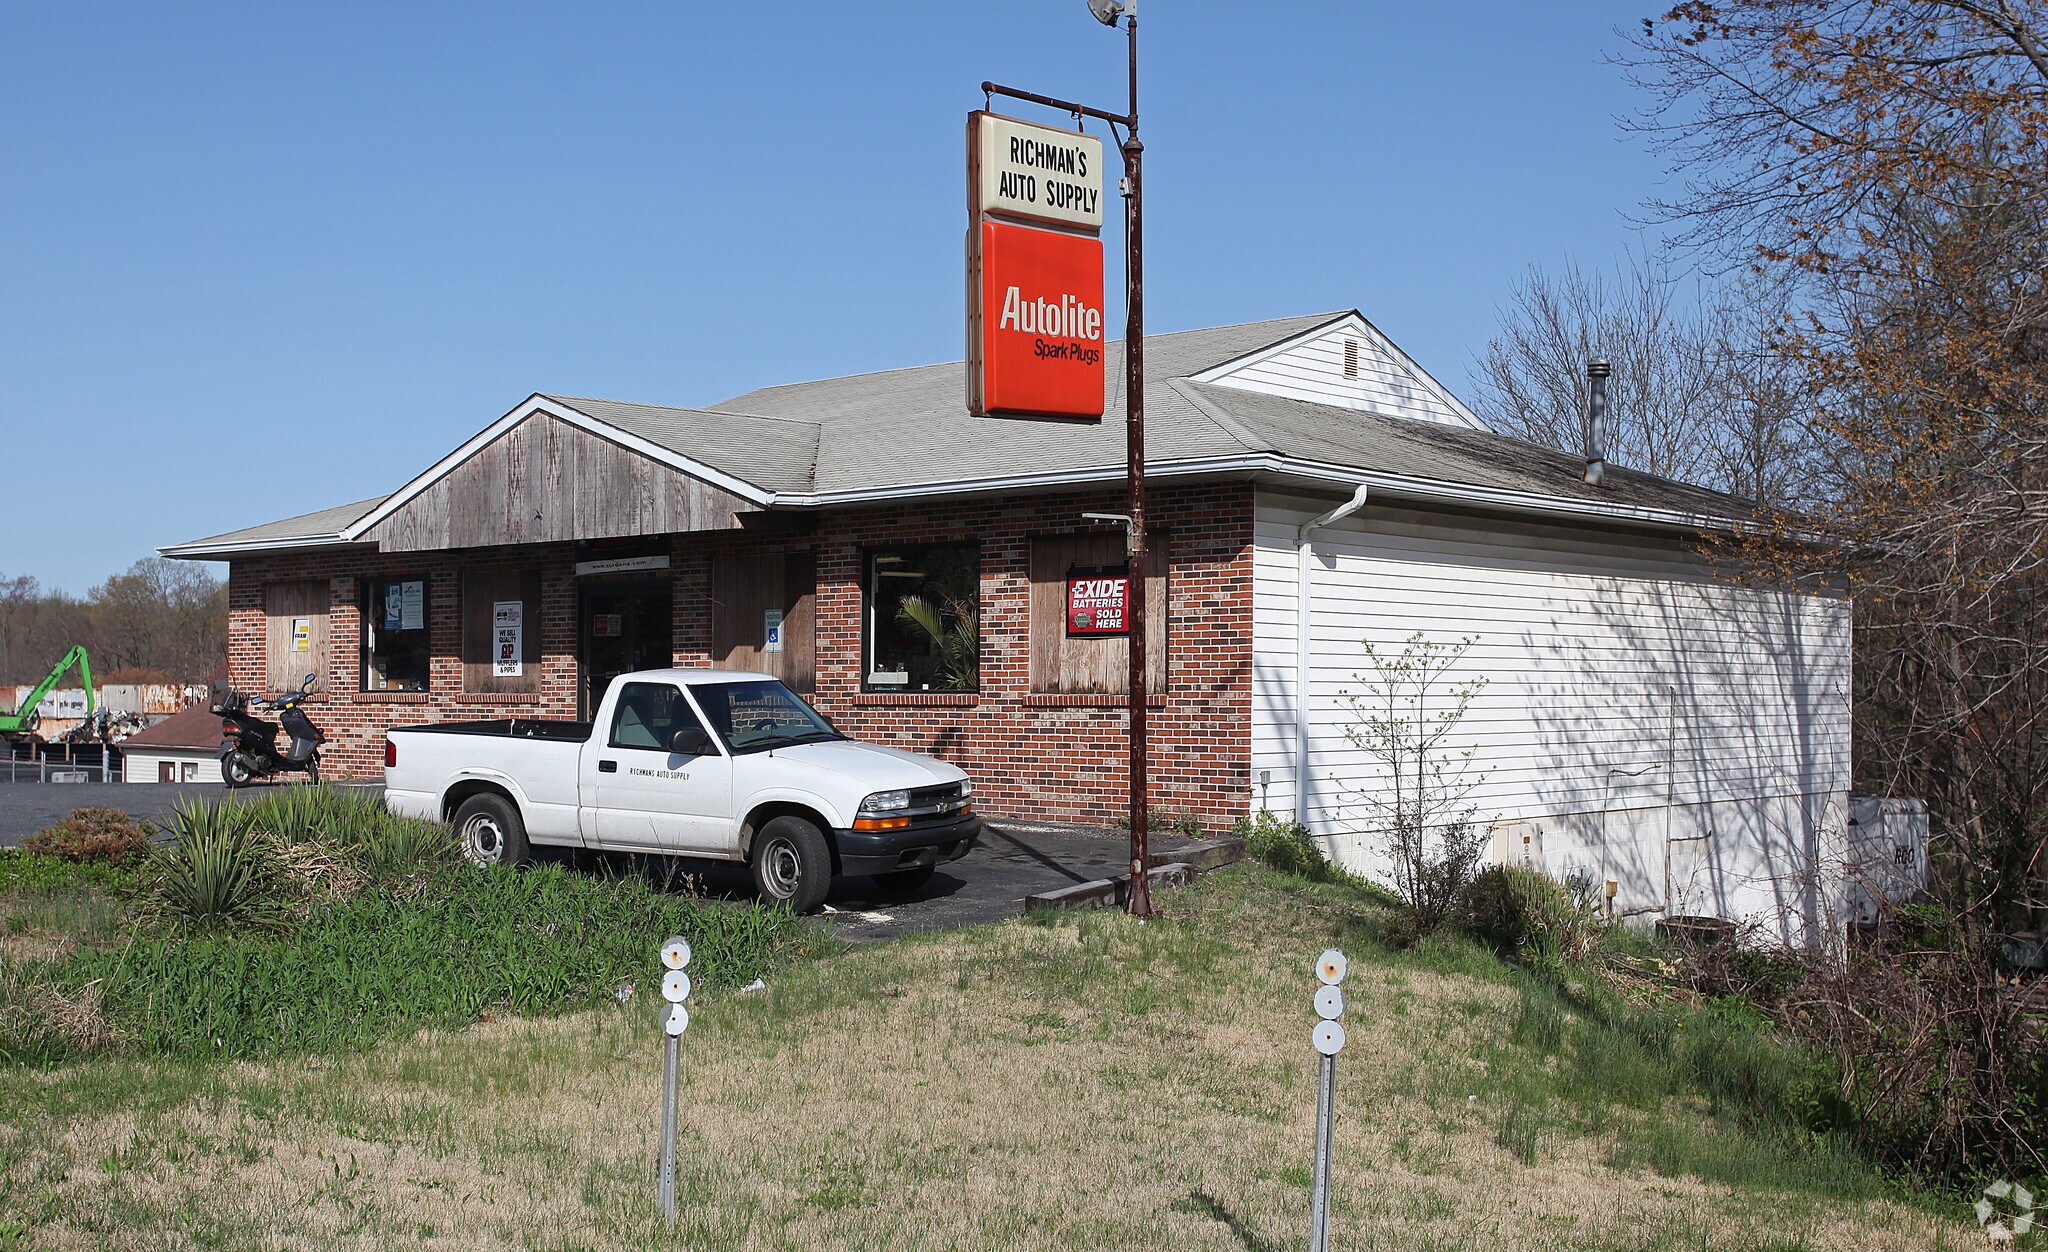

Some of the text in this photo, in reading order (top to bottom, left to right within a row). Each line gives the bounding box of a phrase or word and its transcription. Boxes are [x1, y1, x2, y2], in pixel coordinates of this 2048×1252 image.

[1010, 136, 1087, 178] RICHMAN'S
[999, 170, 1098, 214] AUTO SUPPLY
[1000, 285, 1101, 341] Autolite
[1034, 338, 1100, 366] Spark Plugs
[1071, 579, 1127, 599] EXIDE
[1072, 598, 1124, 609] BATTERIES
[1095, 619, 1123, 629] HERE
[1096, 609, 1122, 619] SOLD
[630, 768, 690, 780] RICHMANS AUTO SUPPLY
